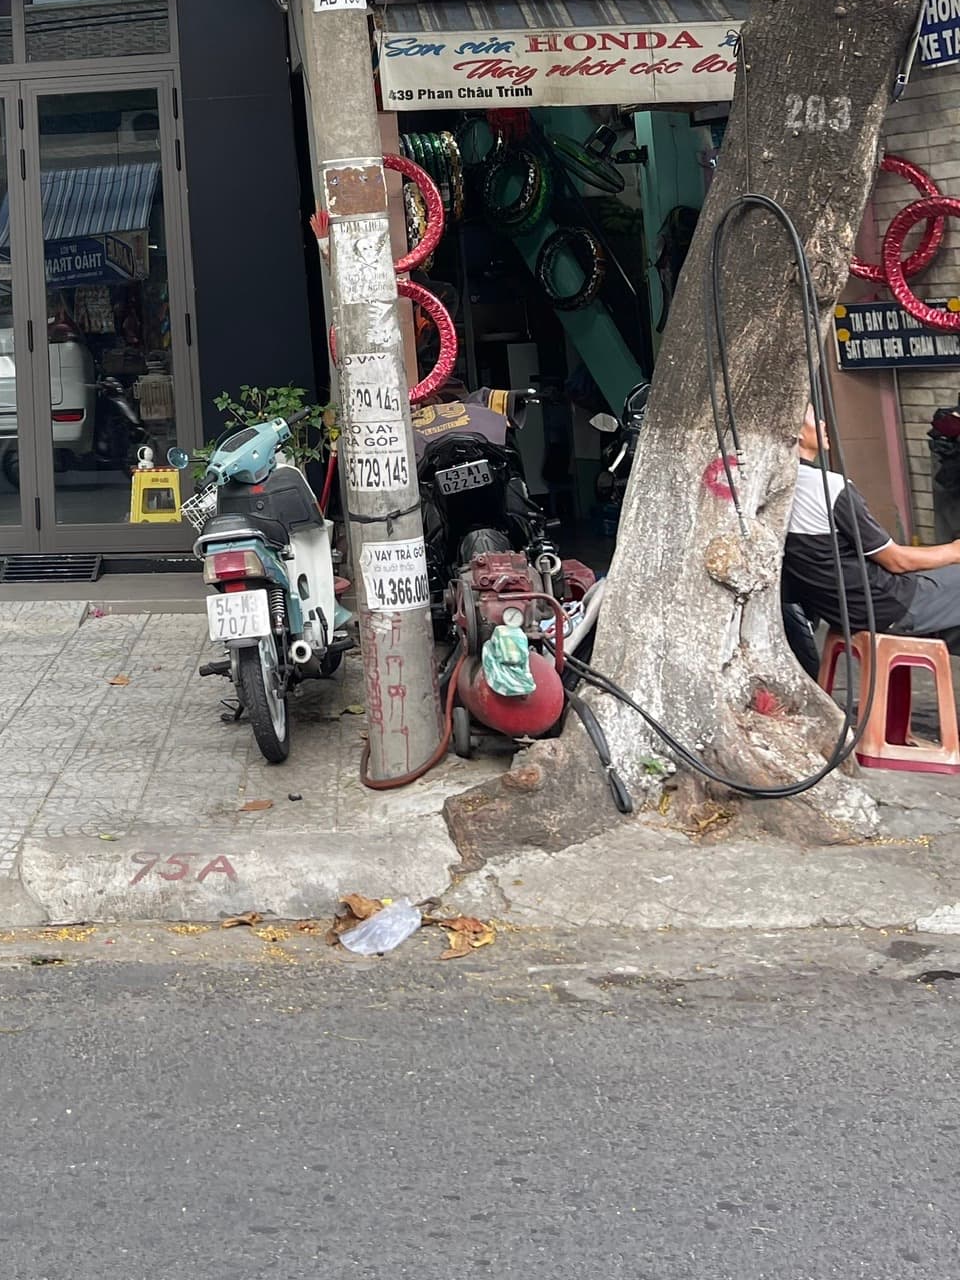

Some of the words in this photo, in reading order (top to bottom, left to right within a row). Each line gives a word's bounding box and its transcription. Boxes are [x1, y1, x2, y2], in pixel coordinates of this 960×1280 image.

[524, 30, 704, 54] HONDA
[920, 32, 941, 61] XE
[453, 58, 538, 85] Thay
[389, 89, 414, 101] 439
[418, 88, 453, 100] Phan
[458, 86, 493, 99] Châu
[364, 435, 399, 448] GÓP
[445, 465, 480, 481] 43-A1
[375, 550, 392, 561] VAY
[395, 544, 412, 559] TRẢ
[128, 850, 239, 886] 95A
